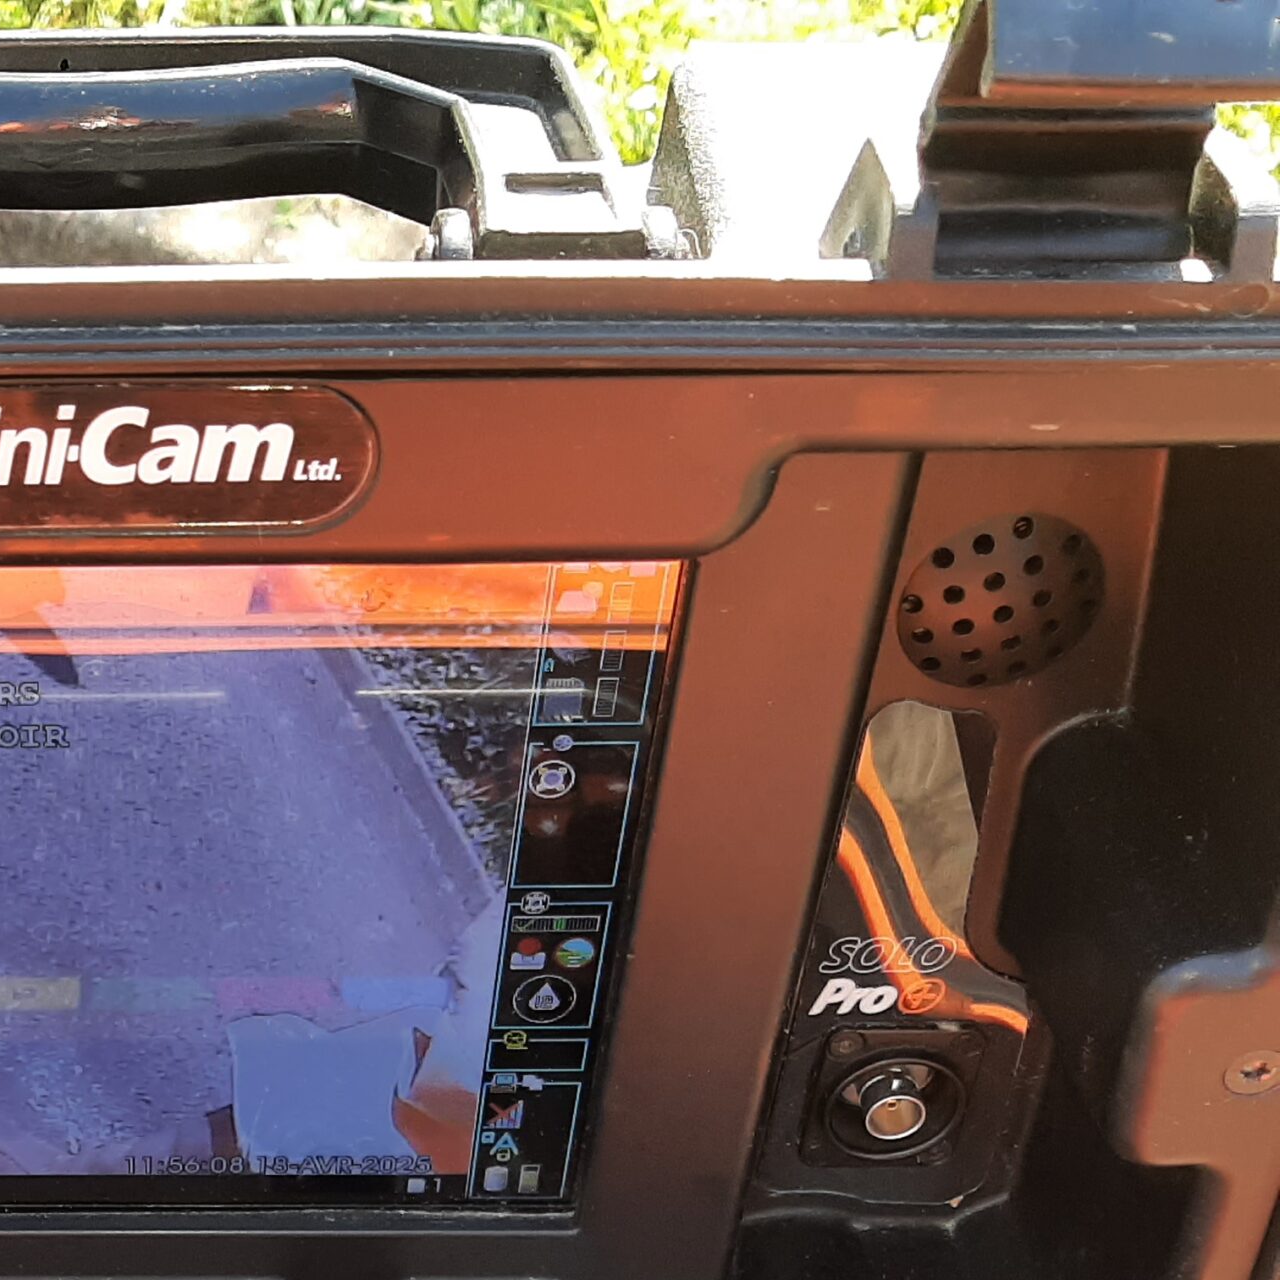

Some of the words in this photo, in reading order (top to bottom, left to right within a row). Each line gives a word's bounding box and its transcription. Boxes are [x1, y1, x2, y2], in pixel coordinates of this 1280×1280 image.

[294, 459, 341, 482] Ltd.
[818, 936, 957, 974] SOLO
[124, 1155, 245, 1175] 11:56:08
[256, 1155, 432, 1175] 18-AVR-2025
